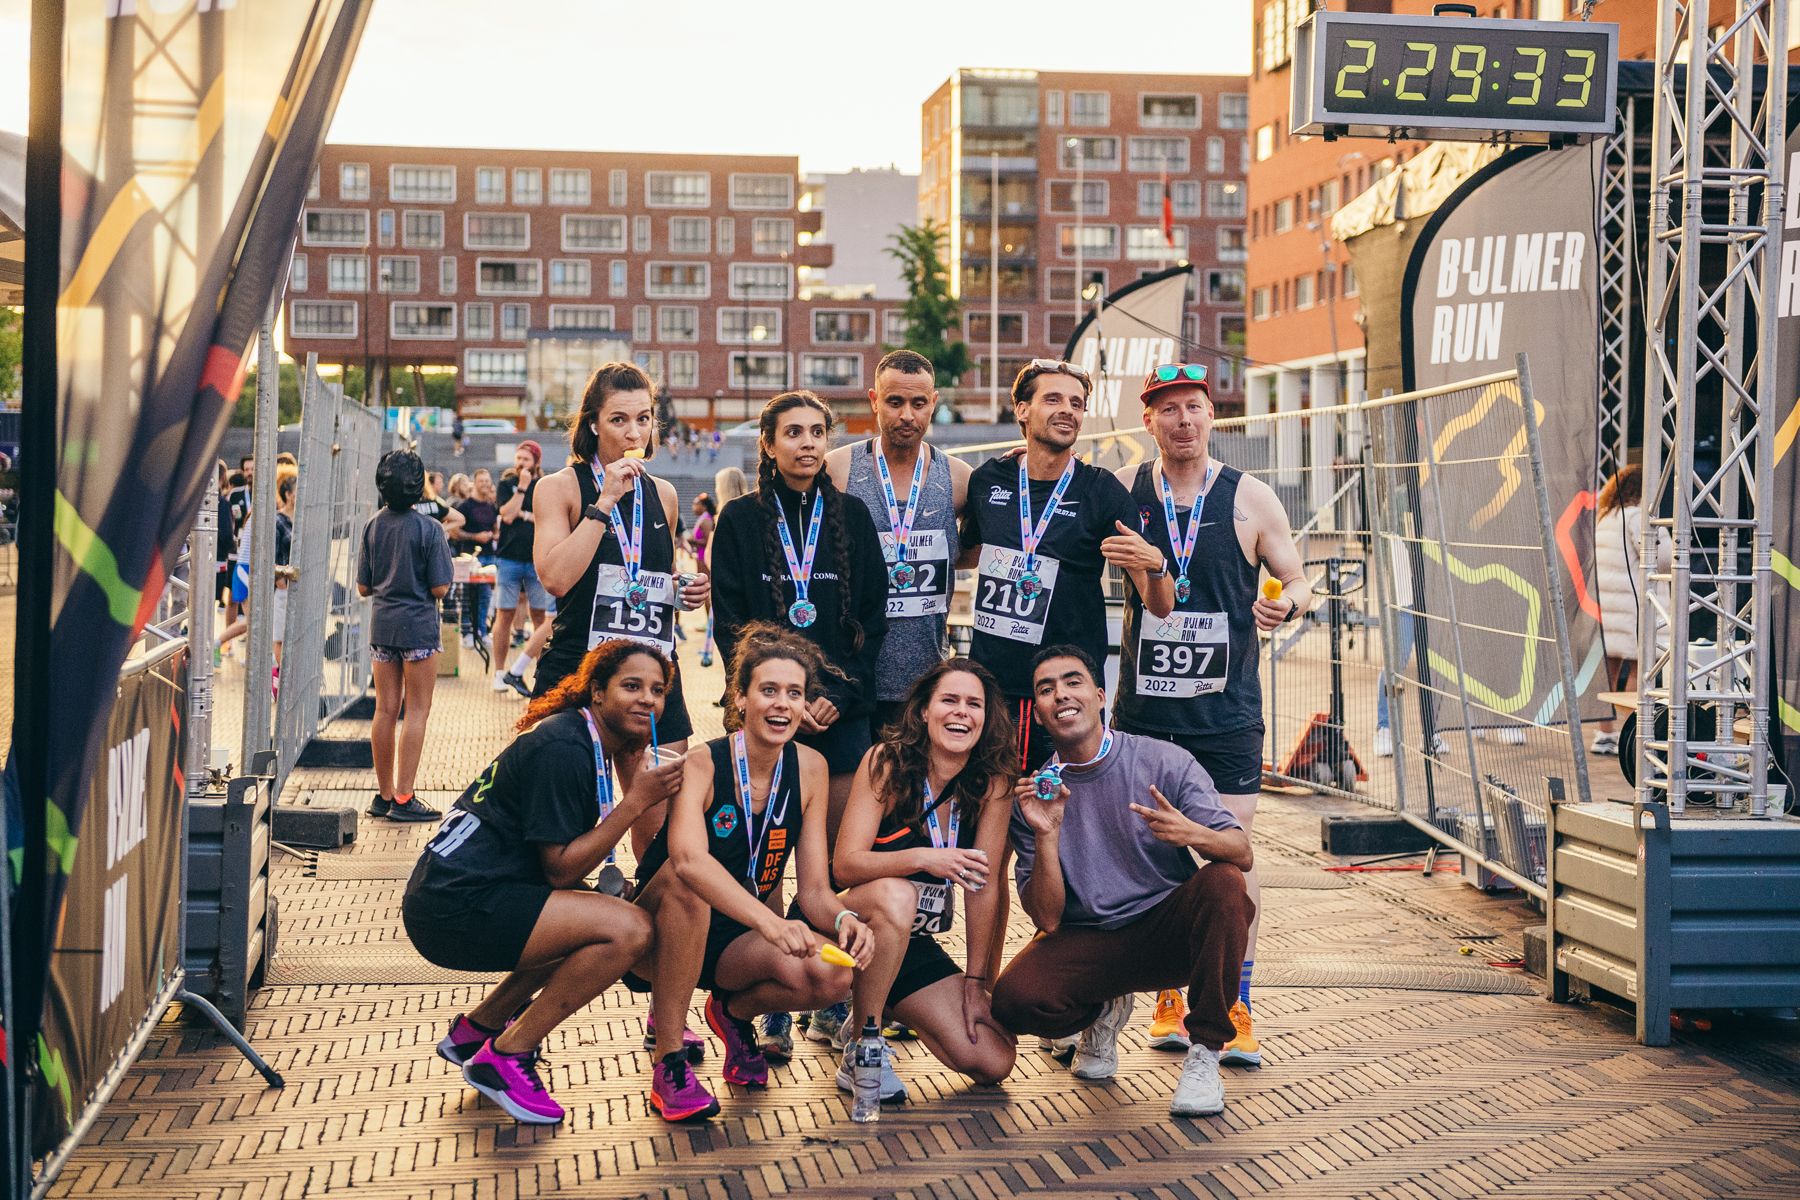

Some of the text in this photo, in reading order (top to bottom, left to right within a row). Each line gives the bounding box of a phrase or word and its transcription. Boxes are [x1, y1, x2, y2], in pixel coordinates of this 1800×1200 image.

[1436, 231, 1587, 298] BIJLMER
[1430, 301, 1505, 365] RUN
[1083, 379, 1123, 419] UN
[988, 485, 1013, 503] Patta
[908, 534, 933, 547] IJLMER
[906, 548, 918, 560] UN
[920, 598, 937, 614] Patta
[608, 600, 663, 635] 155
[977, 614, 1031, 636] 2022 Patta
[1183, 616, 1214, 630] BIJLMER
[1181, 630, 1197, 642] RUN
[1151, 644, 1215, 675] 397
[1144, 678, 1214, 694] 2022 Patta
[765, 851, 784, 868] DF
[760, 868, 779, 883] NS
[919, 897, 936, 911] RUN
